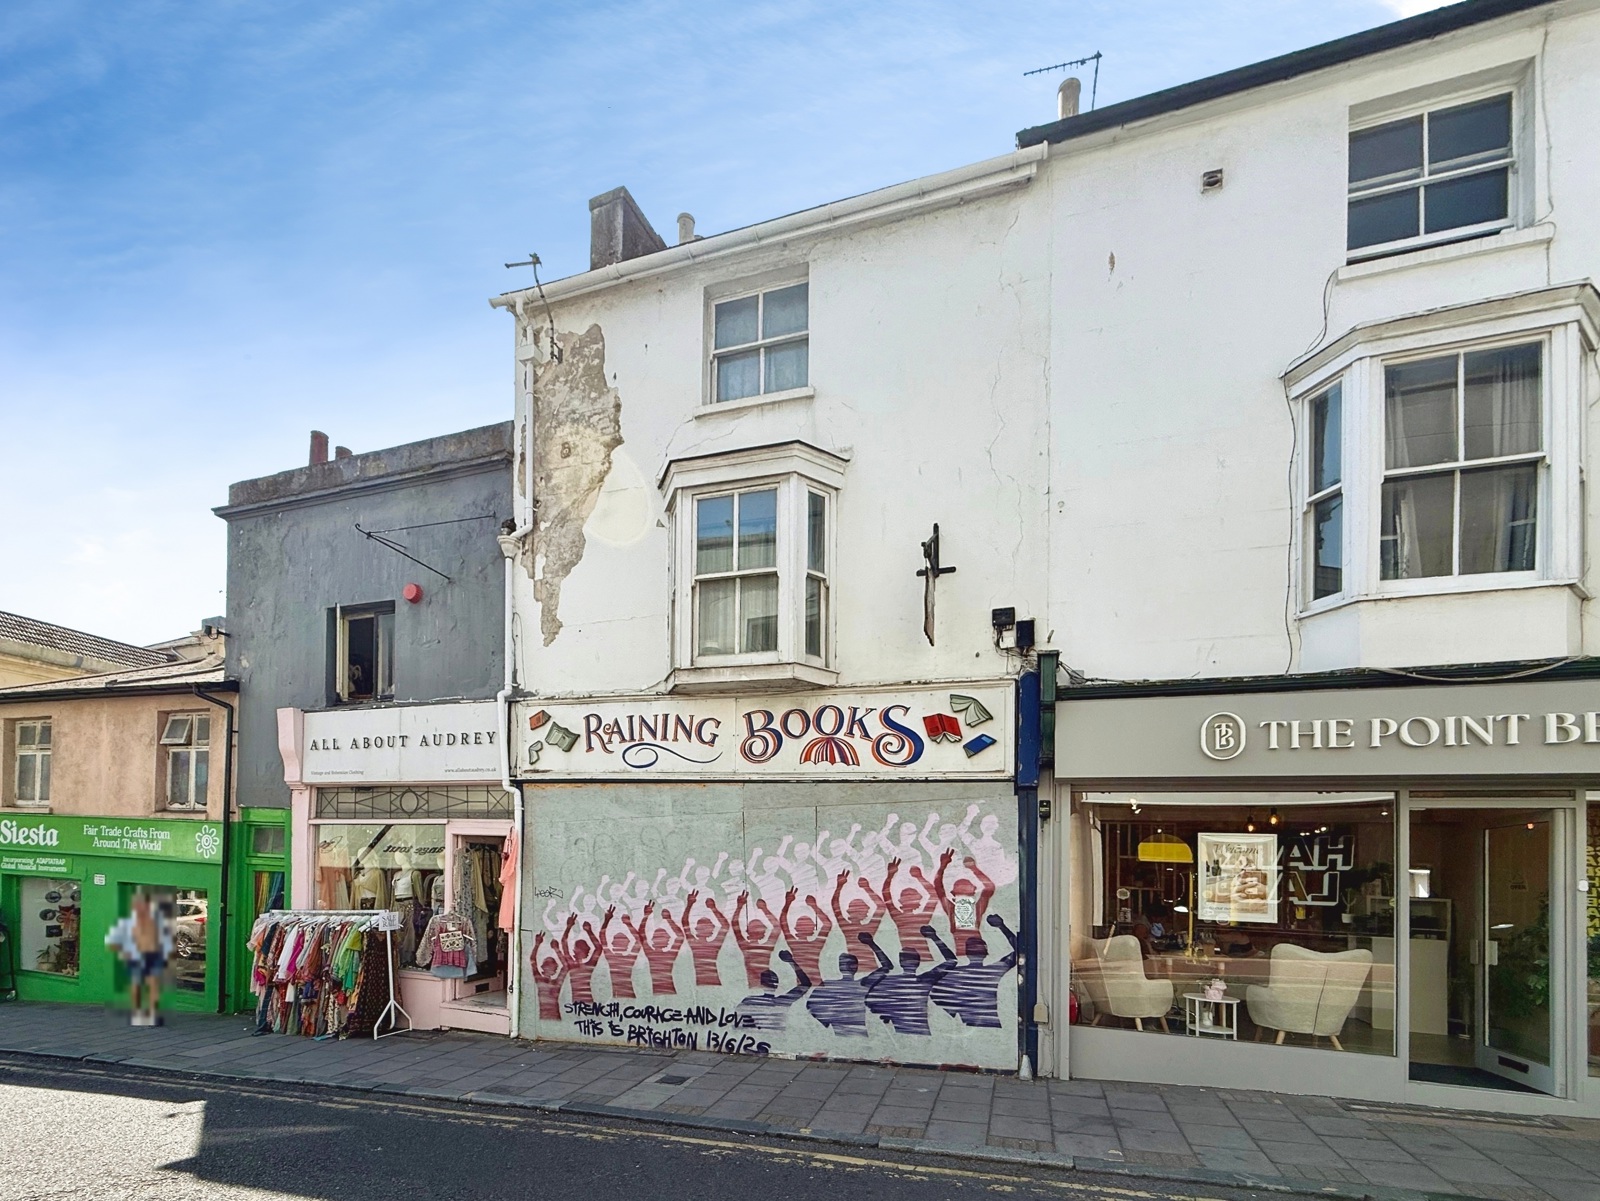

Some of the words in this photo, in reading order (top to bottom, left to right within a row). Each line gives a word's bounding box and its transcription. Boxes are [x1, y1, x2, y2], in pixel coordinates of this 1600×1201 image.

[310, 739, 341, 751] ALL
[350, 735, 409, 750] ABOUT
[419, 731, 497, 747] AUDREY
[583, 713, 722, 754] RAINING
[740, 704, 925, 768] BOOKS
[1259, 719, 1355, 750] THE
[1369, 713, 1530, 749] POINT
[0, 819, 60, 848] Siesta
[83, 824, 99, 836] Fair
[100, 825, 122, 838] Trade
[123, 826, 148, 839] Crafts
[149, 828, 171, 840] From
[93, 837, 120, 849] Around
[122, 838, 138, 850] The
[139, 839, 162, 851] World
[623, 1005, 683, 1024] COURAGE
[684, 1006, 718, 1025] AND
